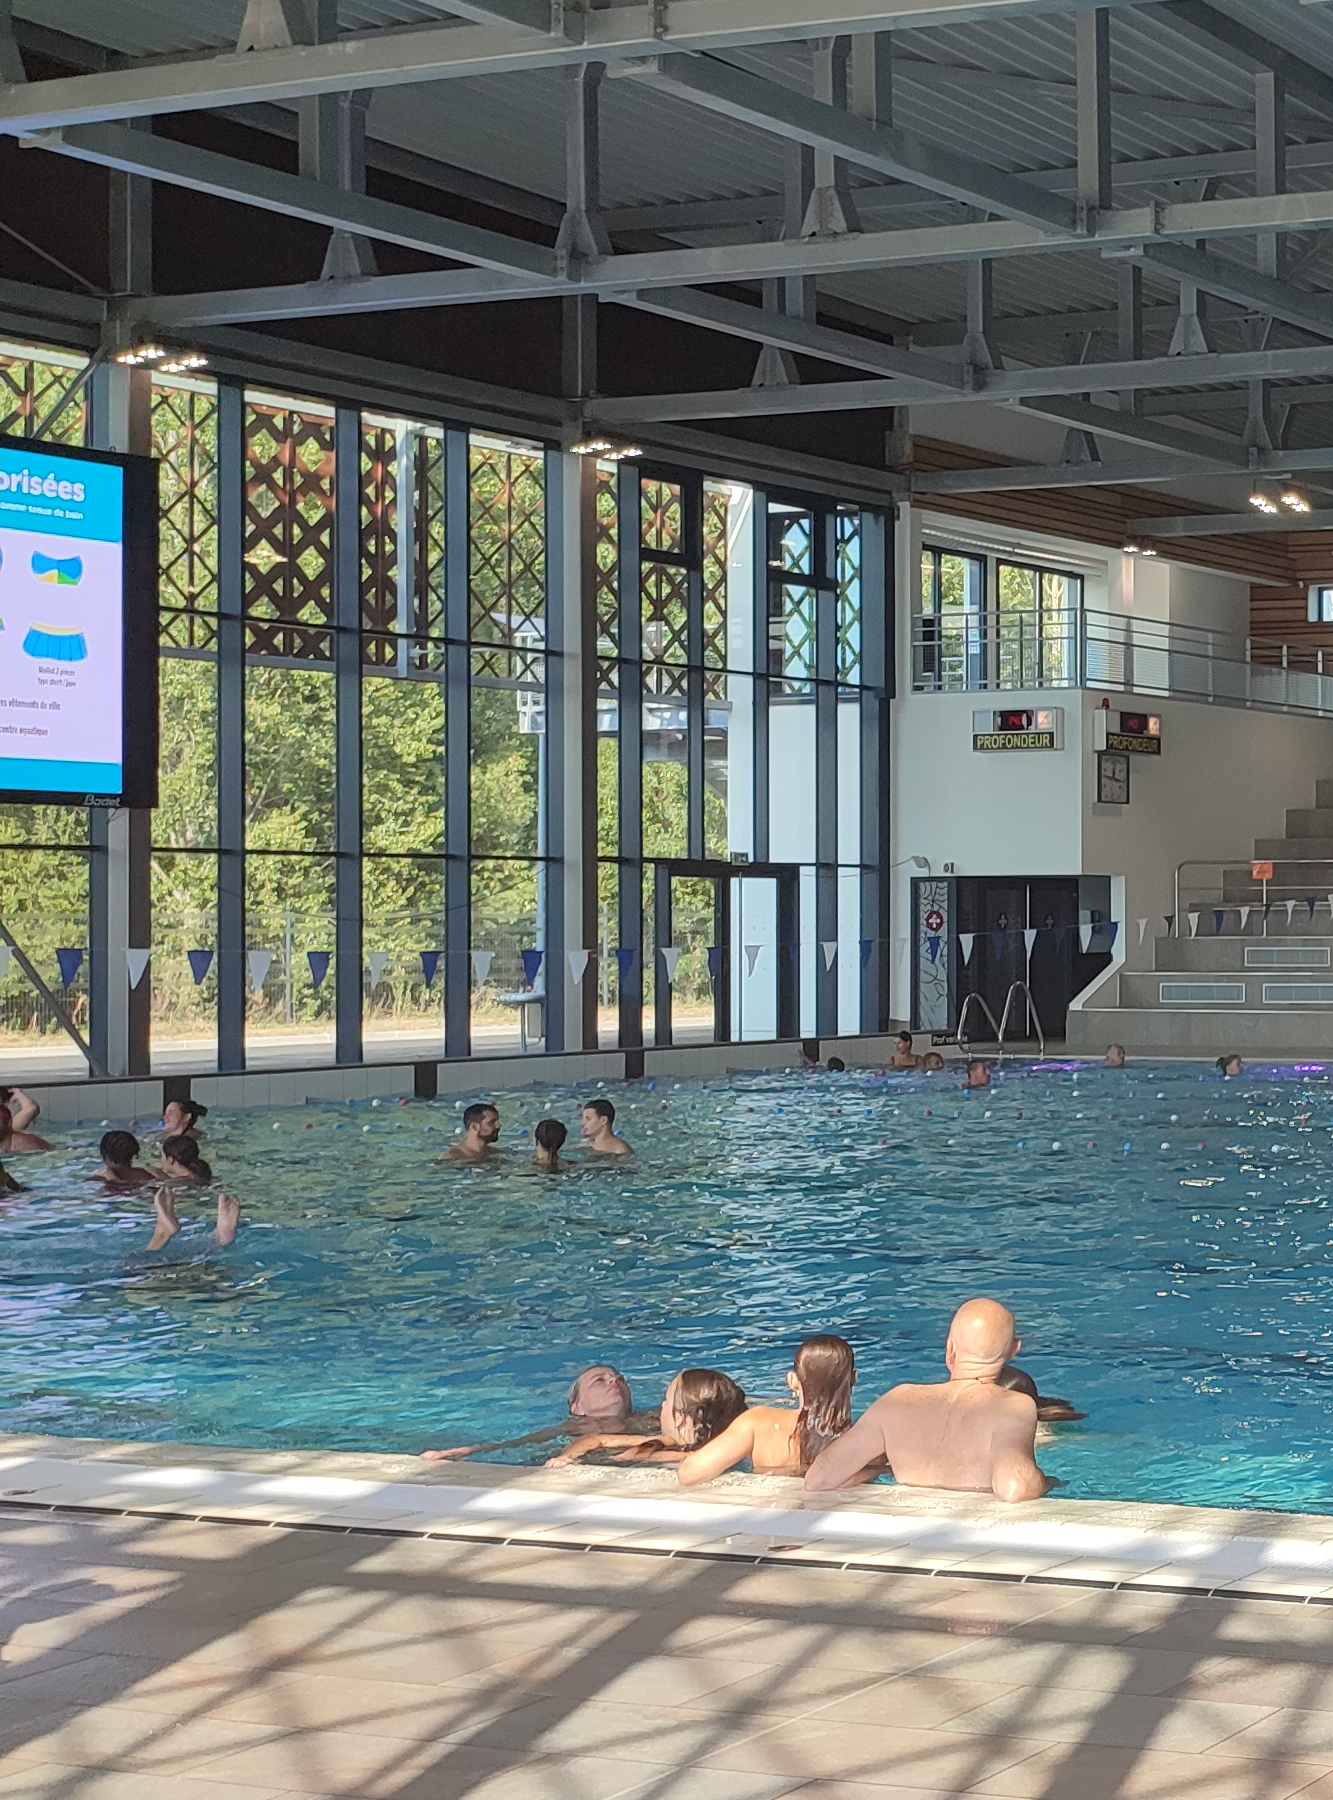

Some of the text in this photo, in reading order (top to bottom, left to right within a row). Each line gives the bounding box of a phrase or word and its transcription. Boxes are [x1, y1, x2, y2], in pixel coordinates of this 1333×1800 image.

[0, 468, 85, 502] orisées
[976, 733, 1051, 749] PROFONDEUR
[1108, 735, 1158, 752] PROFONDEUR
